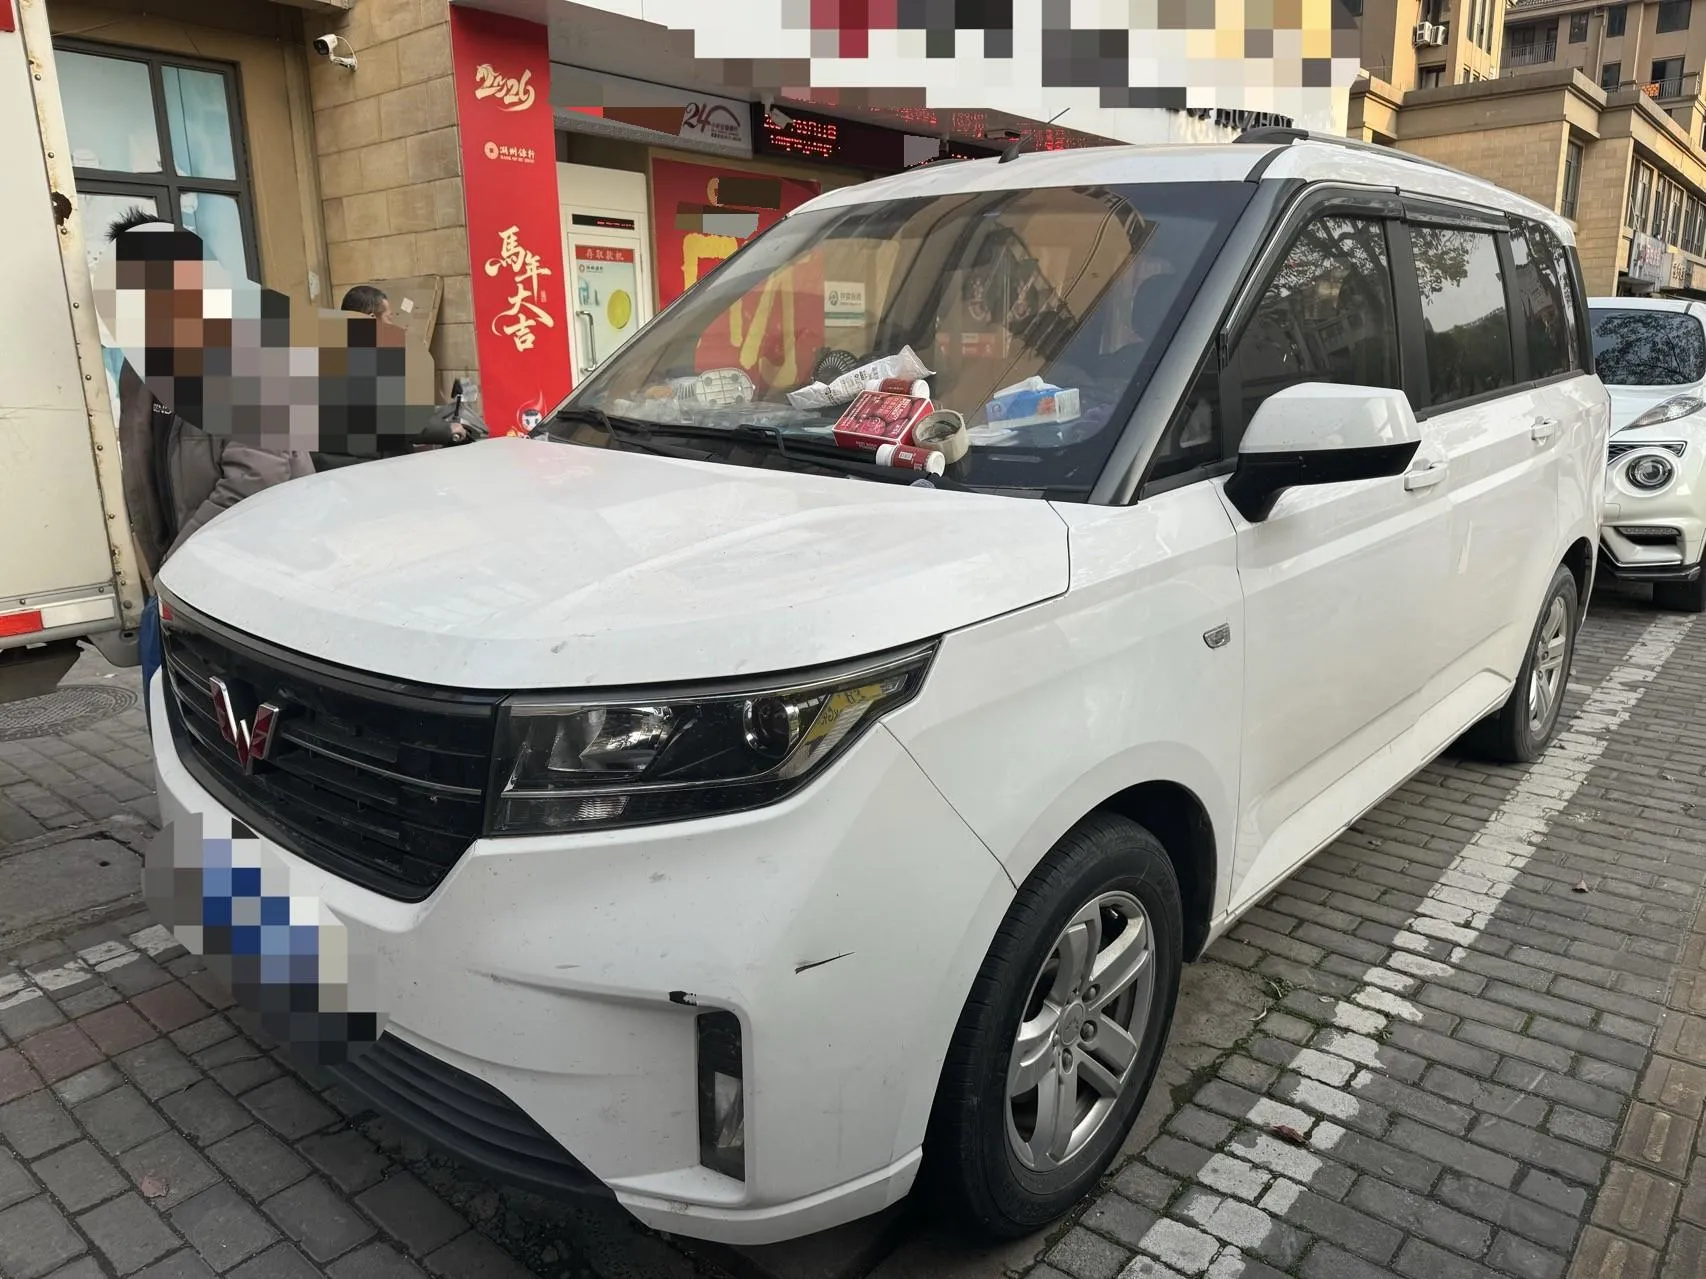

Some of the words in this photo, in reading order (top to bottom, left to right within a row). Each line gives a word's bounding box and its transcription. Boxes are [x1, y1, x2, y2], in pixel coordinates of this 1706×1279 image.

[684, 103, 710, 133] 24
[484, 225, 554, 352] 馬年大吉
